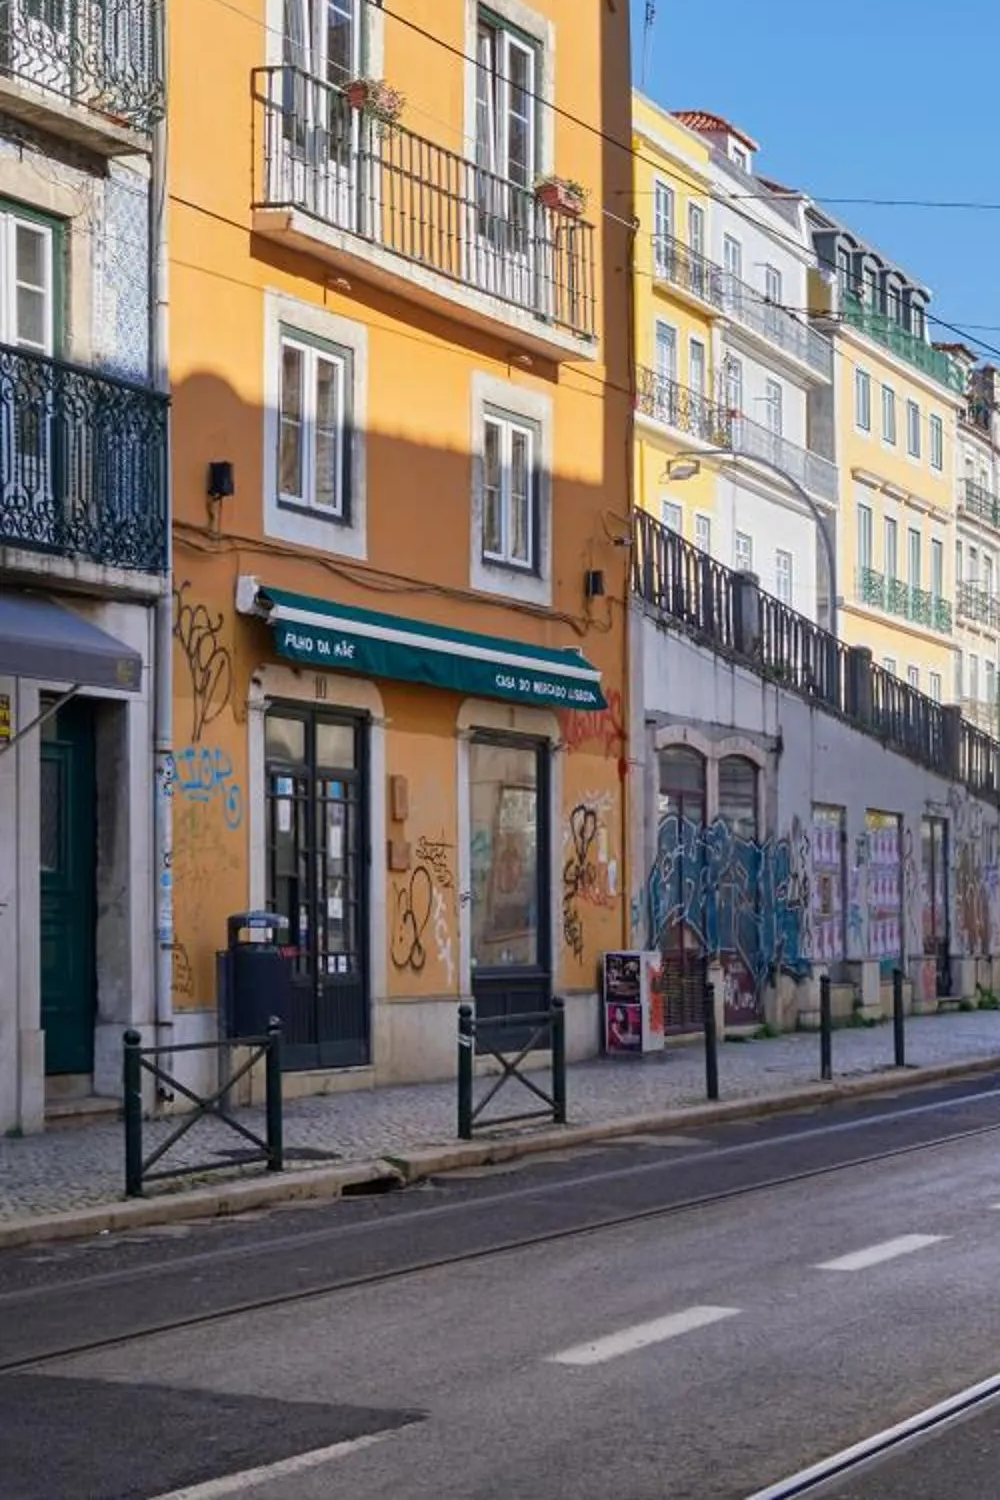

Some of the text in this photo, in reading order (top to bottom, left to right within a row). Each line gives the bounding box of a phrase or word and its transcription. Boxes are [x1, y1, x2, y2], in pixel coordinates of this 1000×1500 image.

[284, 632, 313, 652] FILHO
[317, 639, 331, 655] DA
[495, 674, 517, 689] CASA
[519, 678, 531, 693] DO
